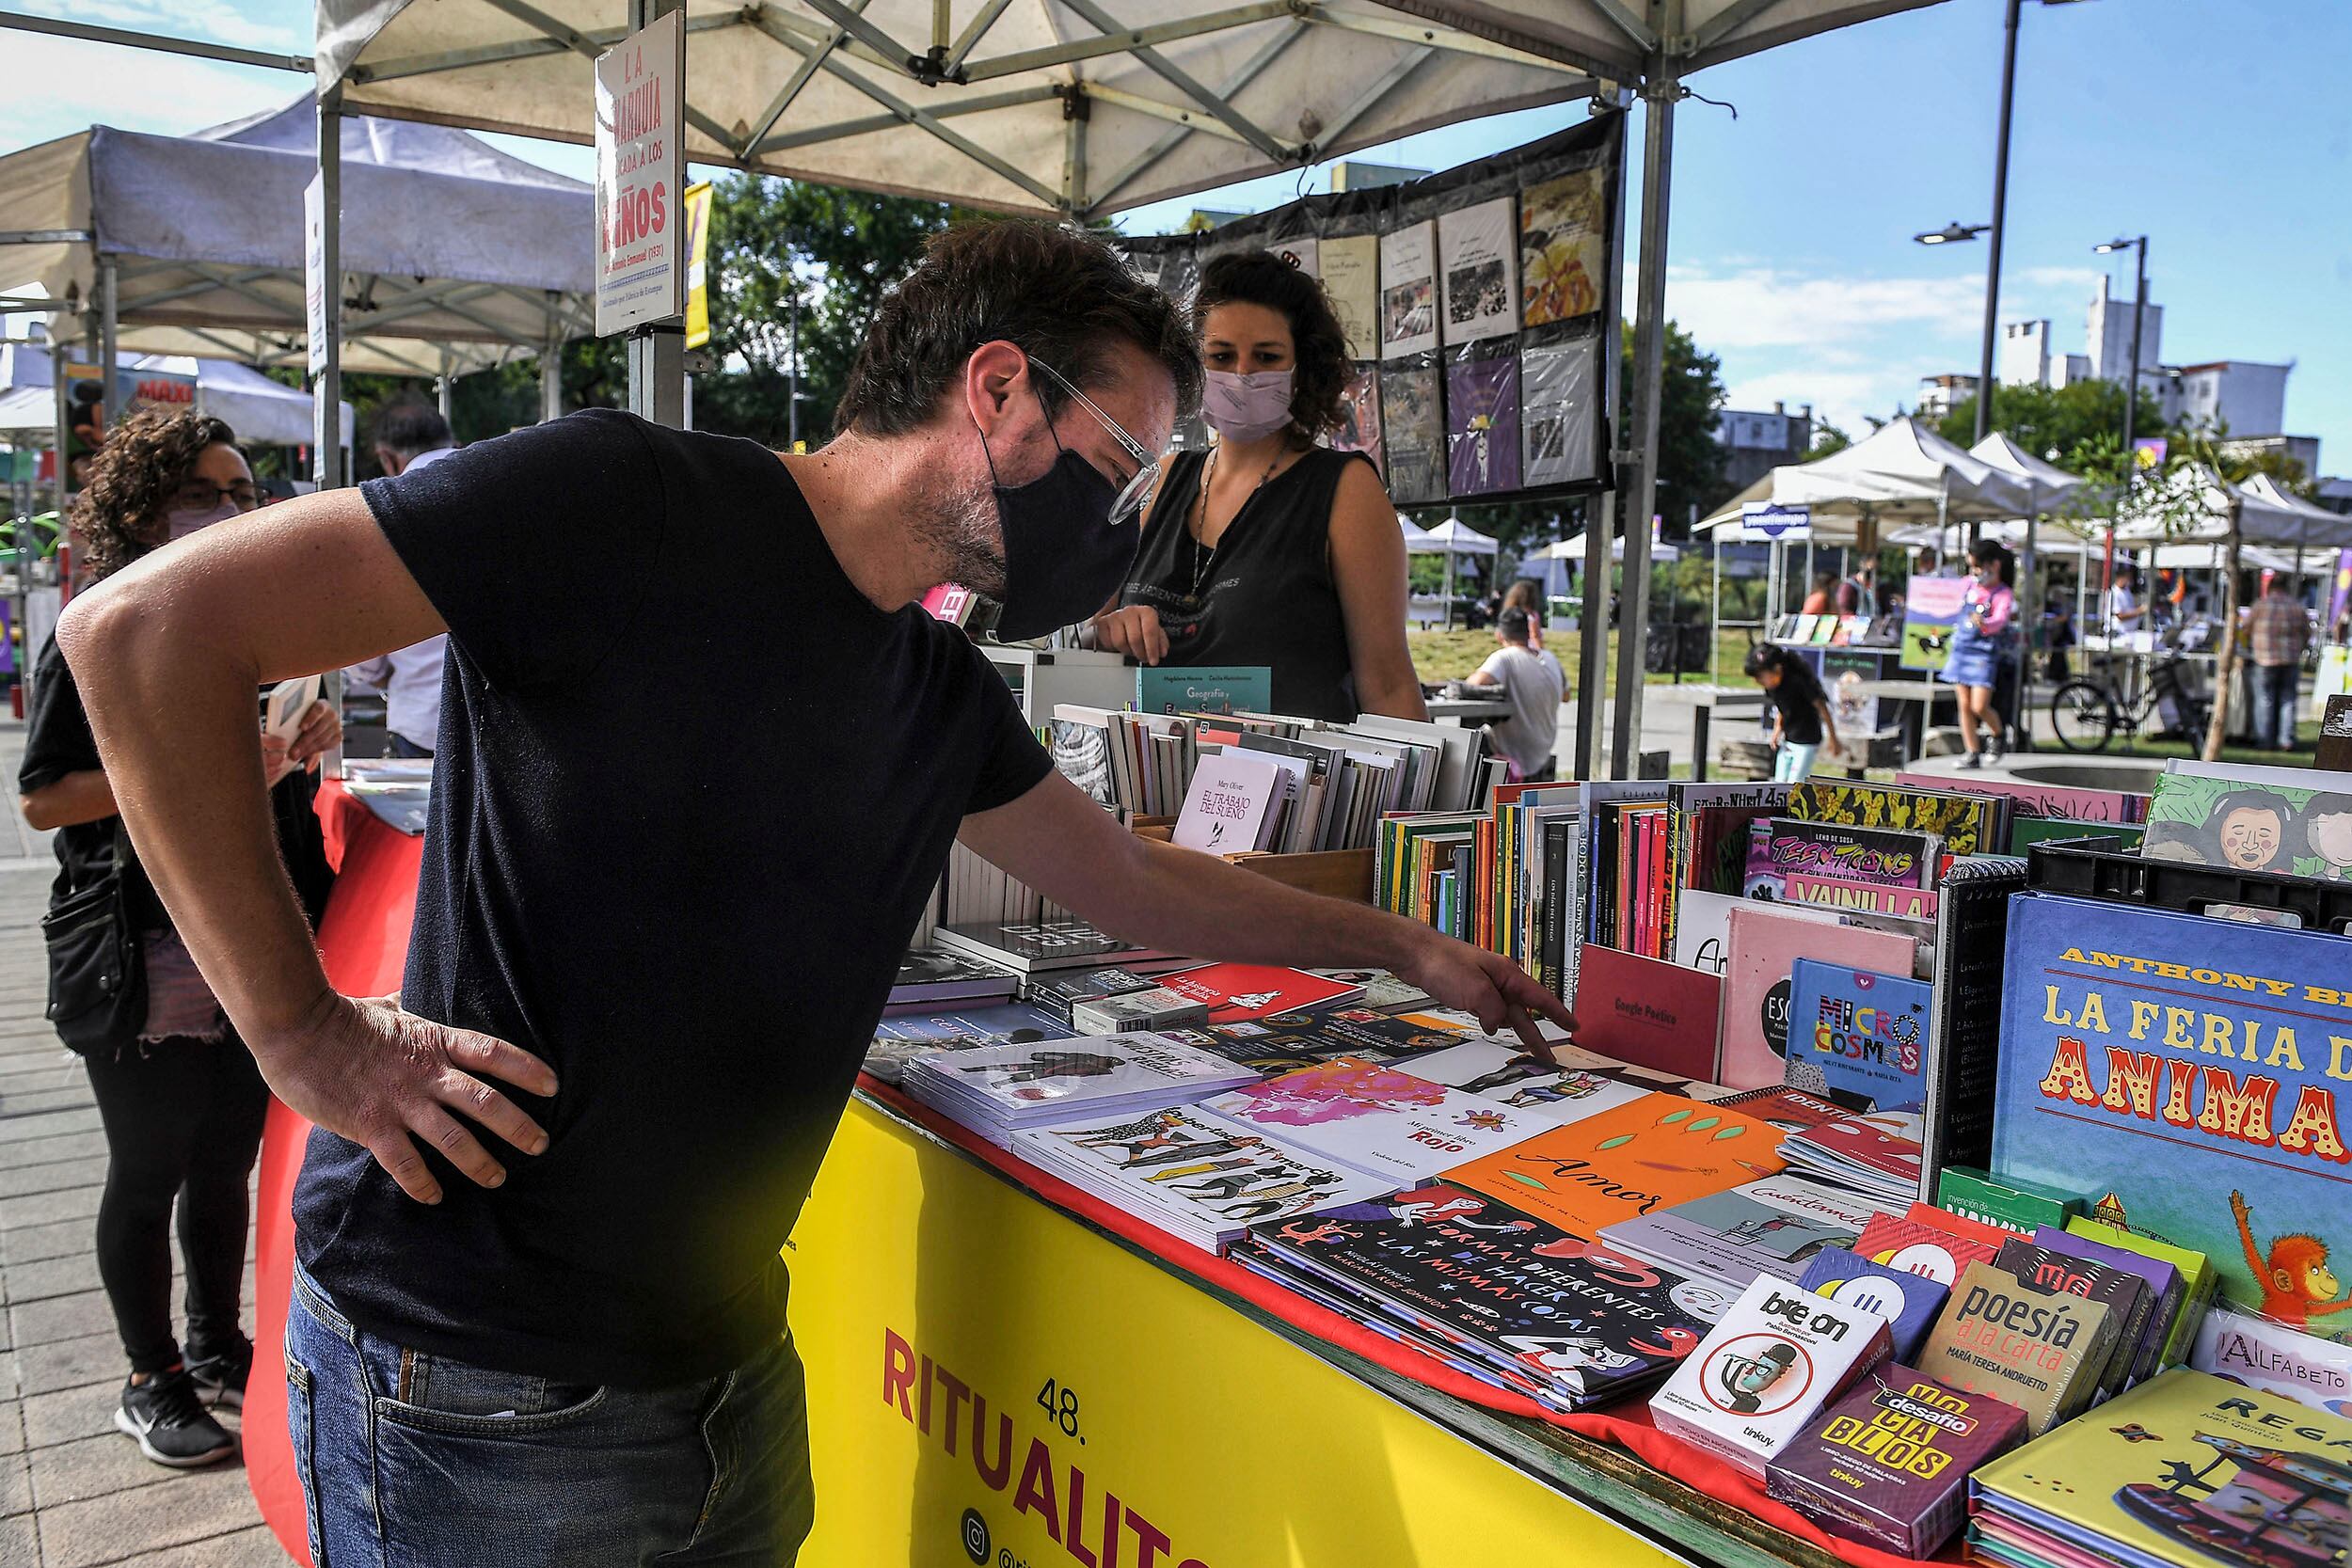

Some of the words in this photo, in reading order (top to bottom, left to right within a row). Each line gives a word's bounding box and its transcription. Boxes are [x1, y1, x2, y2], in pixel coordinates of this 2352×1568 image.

[648, 140, 662, 164] LOS
[648, 244, 664, 261] (1931)
[1186, 687, 1225, 701] Geografía
[1200, 801, 1215, 815] DEL
[1202, 790, 1215, 801] EL
[1214, 793, 1251, 809] TRABAJO
[1217, 780, 1229, 790] Mary
[1230, 782, 1245, 791] Oliver
[1577, 837, 1587, 883] BODOC
[2059, 947, 2296, 998] ANTHONY
[1614, 997, 1643, 1016] Google
[1819, 994, 1920, 1046] MICRO
[2042, 985, 2111, 1035] LA
[2129, 1000, 2305, 1071] FERIA
[1814, 1027, 1922, 1077] COSMOS
[1407, 1130, 1465, 1153] Rojo
[1420, 1123, 1454, 1138] primer
[1454, 1133, 1477, 1147] libro
[1515, 1153, 1662, 1216] Amor
[1947, 1194, 1979, 1212] invención
[1979, 1201, 1988, 1212] de
[1426, 1223, 1530, 1264] FORMAS
[1520, 1260, 1665, 1321] DIFERENTES
[1663, 1227, 1705, 1247] preguntas
[1705, 1238, 1756, 1262] realizadas
[1756, 1259, 1773, 1272] por
[1773, 1265, 1800, 1279] niños
[1671, 1236, 1695, 1248] sobre
[1708, 1248, 1734, 1261] tema
[1734, 1257, 1793, 1284] apasionante
[1328, 1252, 1377, 1278] MARIANA
[1375, 1272, 1404, 1290] RUIZ
[1401, 1283, 1450, 1311] JOHNSON
[1377, 1238, 1430, 1259] LAS
[1420, 1257, 1526, 1302] MISMAS
[1519, 1299, 1602, 1334] COSAS
[1450, 1250, 1487, 1266] DE
[1485, 1265, 1570, 1303] HACER
[1764, 1321, 1784, 1334] Pablo
[1783, 1327, 1818, 1346] Bernasconi
[1956, 1285, 2080, 1350] poesía
[1957, 1318, 1974, 1338] a
[1977, 1321, 1994, 1346] la
[2001, 1333, 2064, 1372] carta
[2221, 1333, 2346, 1389] ALFABETO
[1946, 1345, 1972, 1363] MARÍA
[1972, 1355, 2000, 1375] TERESA
[2000, 1366, 2049, 1392] ANDRUETTO
[1037, 1377, 1088, 1447] 48.
[1887, 1396, 1969, 1433] desafío
[2199, 1411, 2229, 1426] Juan
[2230, 1421, 2284, 1444] Quintero
[1820, 1446, 1863, 1470] LIBRO-JUEGO
[1862, 1463, 1871, 1471] DE
[1871, 1466, 1907, 1486] PALABRAS
[1826, 1418, 1945, 1475] BLOS
[1829, 1467, 1866, 1490] tinkuy
[1832, 1457, 1854, 1470] incluye
[1864, 1469, 1884, 1483] naipes
